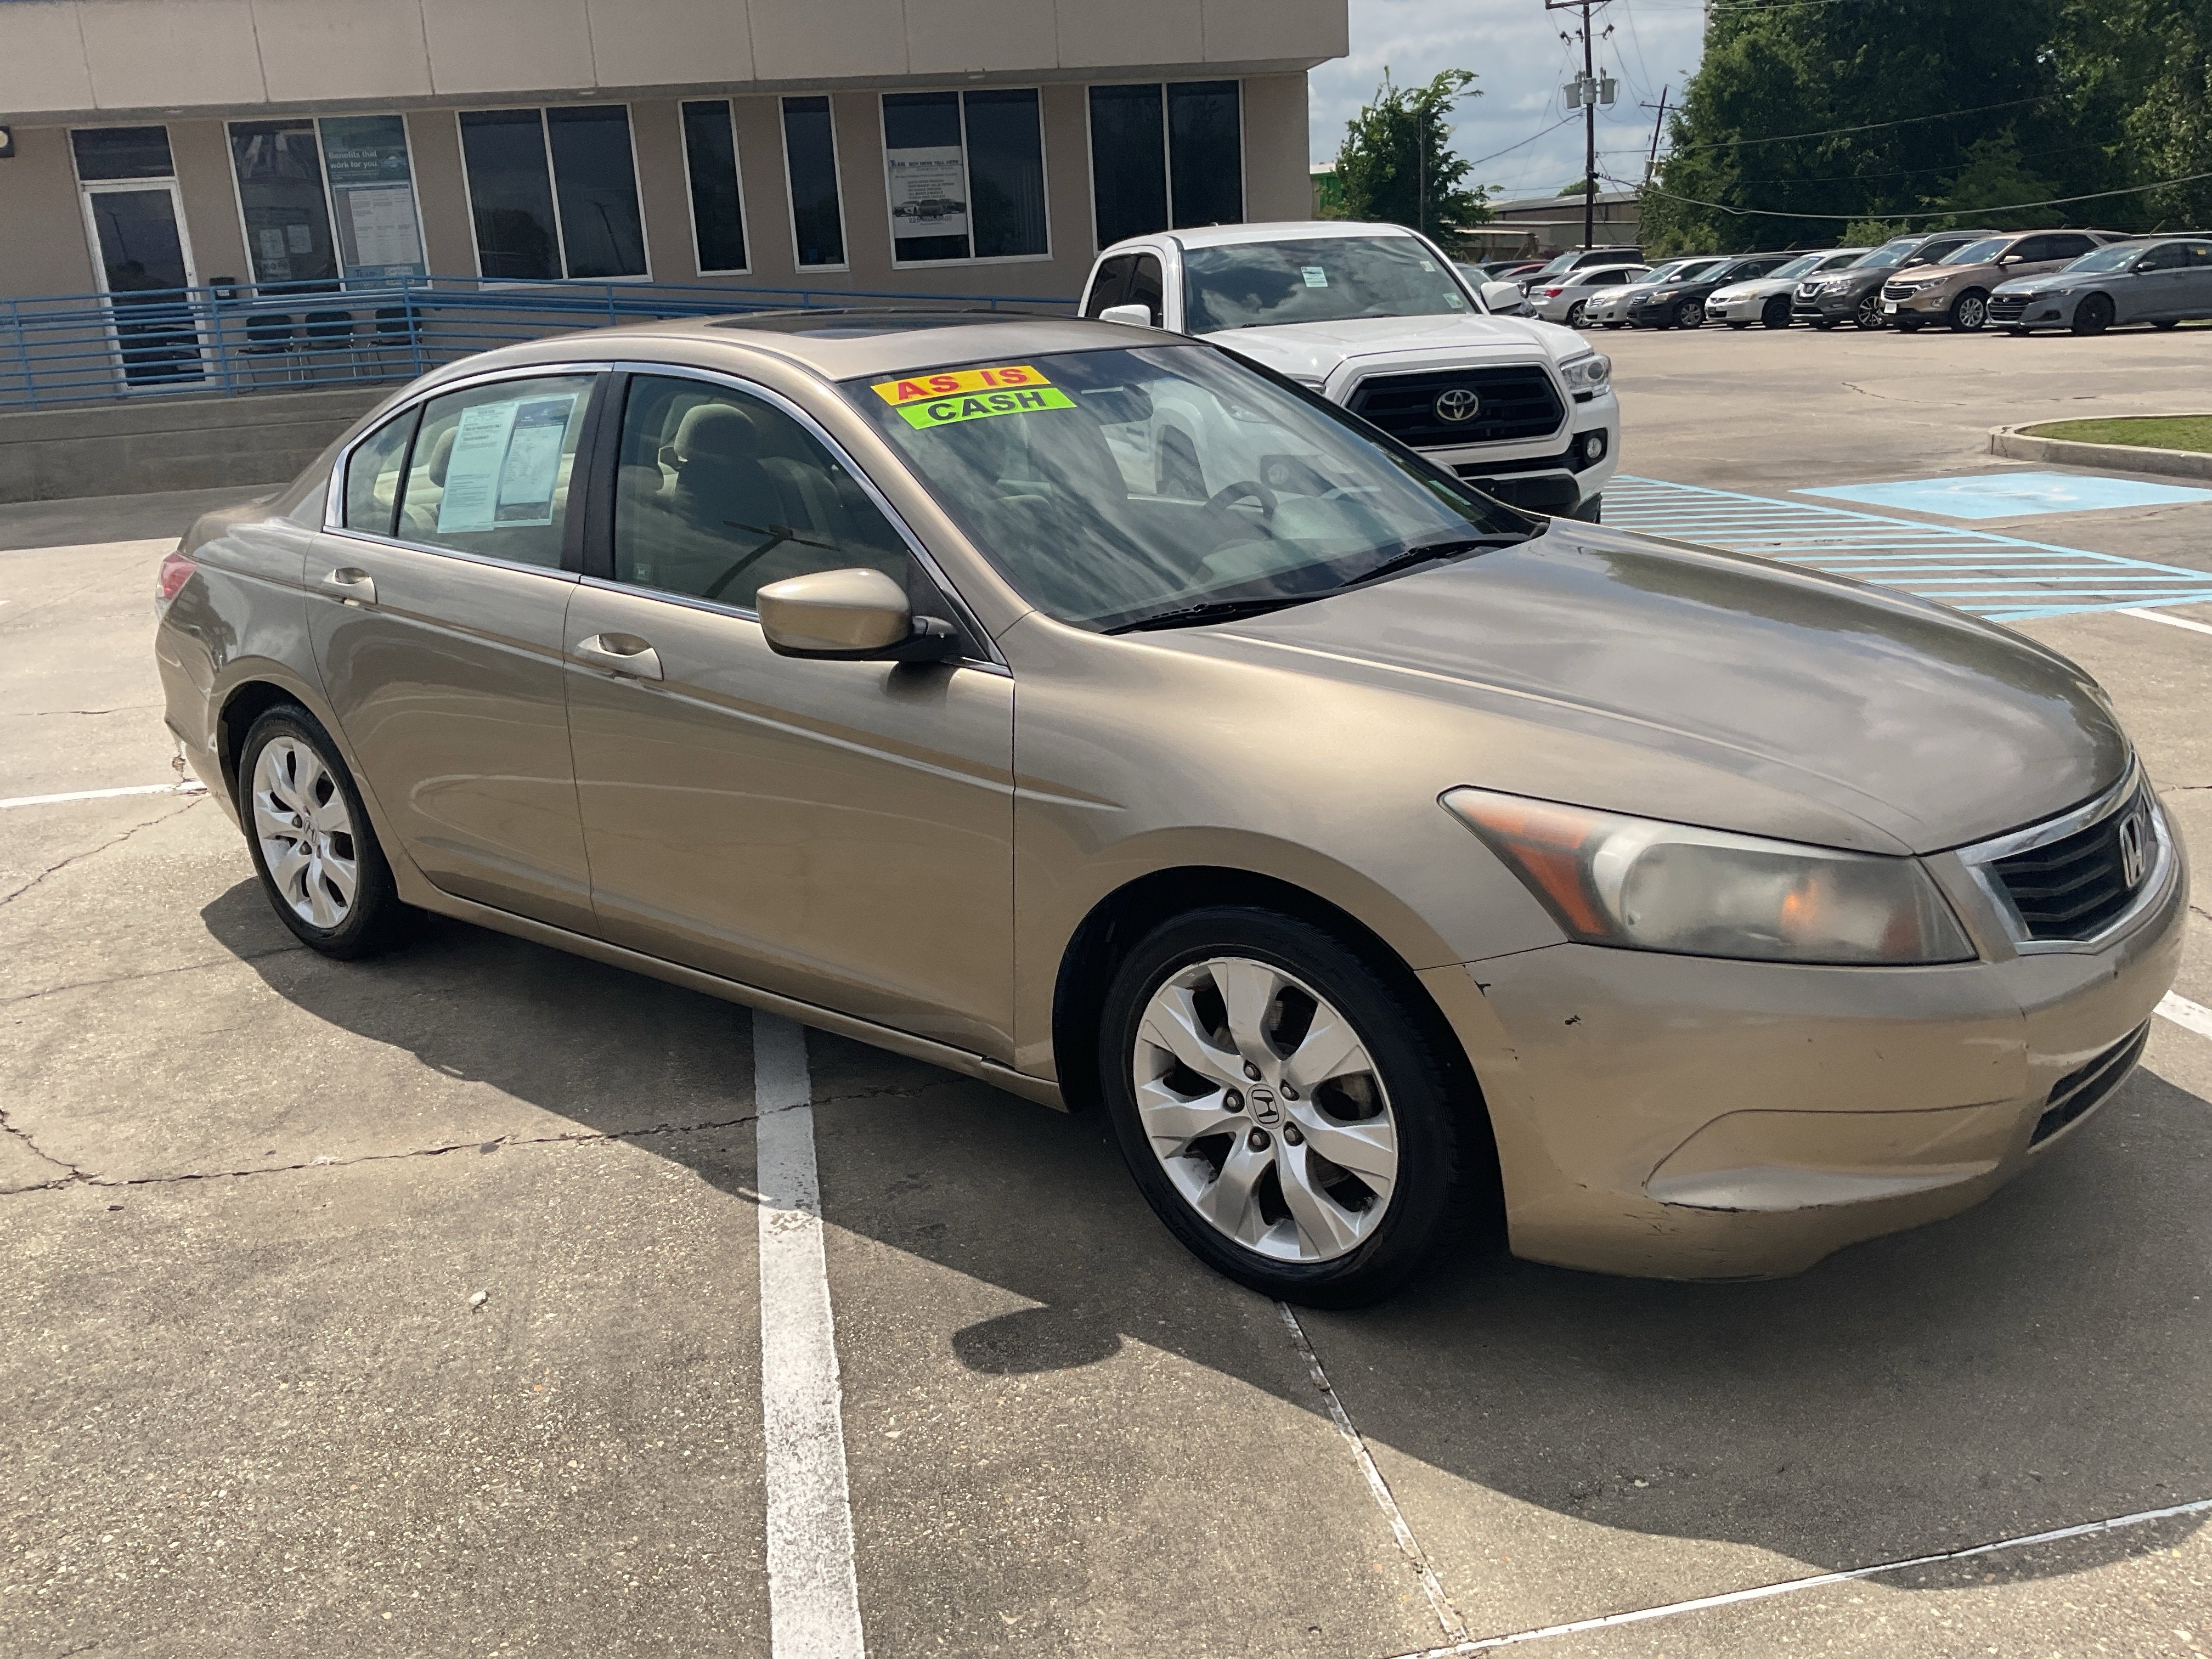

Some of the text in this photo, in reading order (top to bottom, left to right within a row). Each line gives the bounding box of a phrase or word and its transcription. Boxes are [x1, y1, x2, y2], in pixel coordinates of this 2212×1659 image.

[898, 369, 1028, 400] AS IS
[927, 391, 1048, 421] CASH
